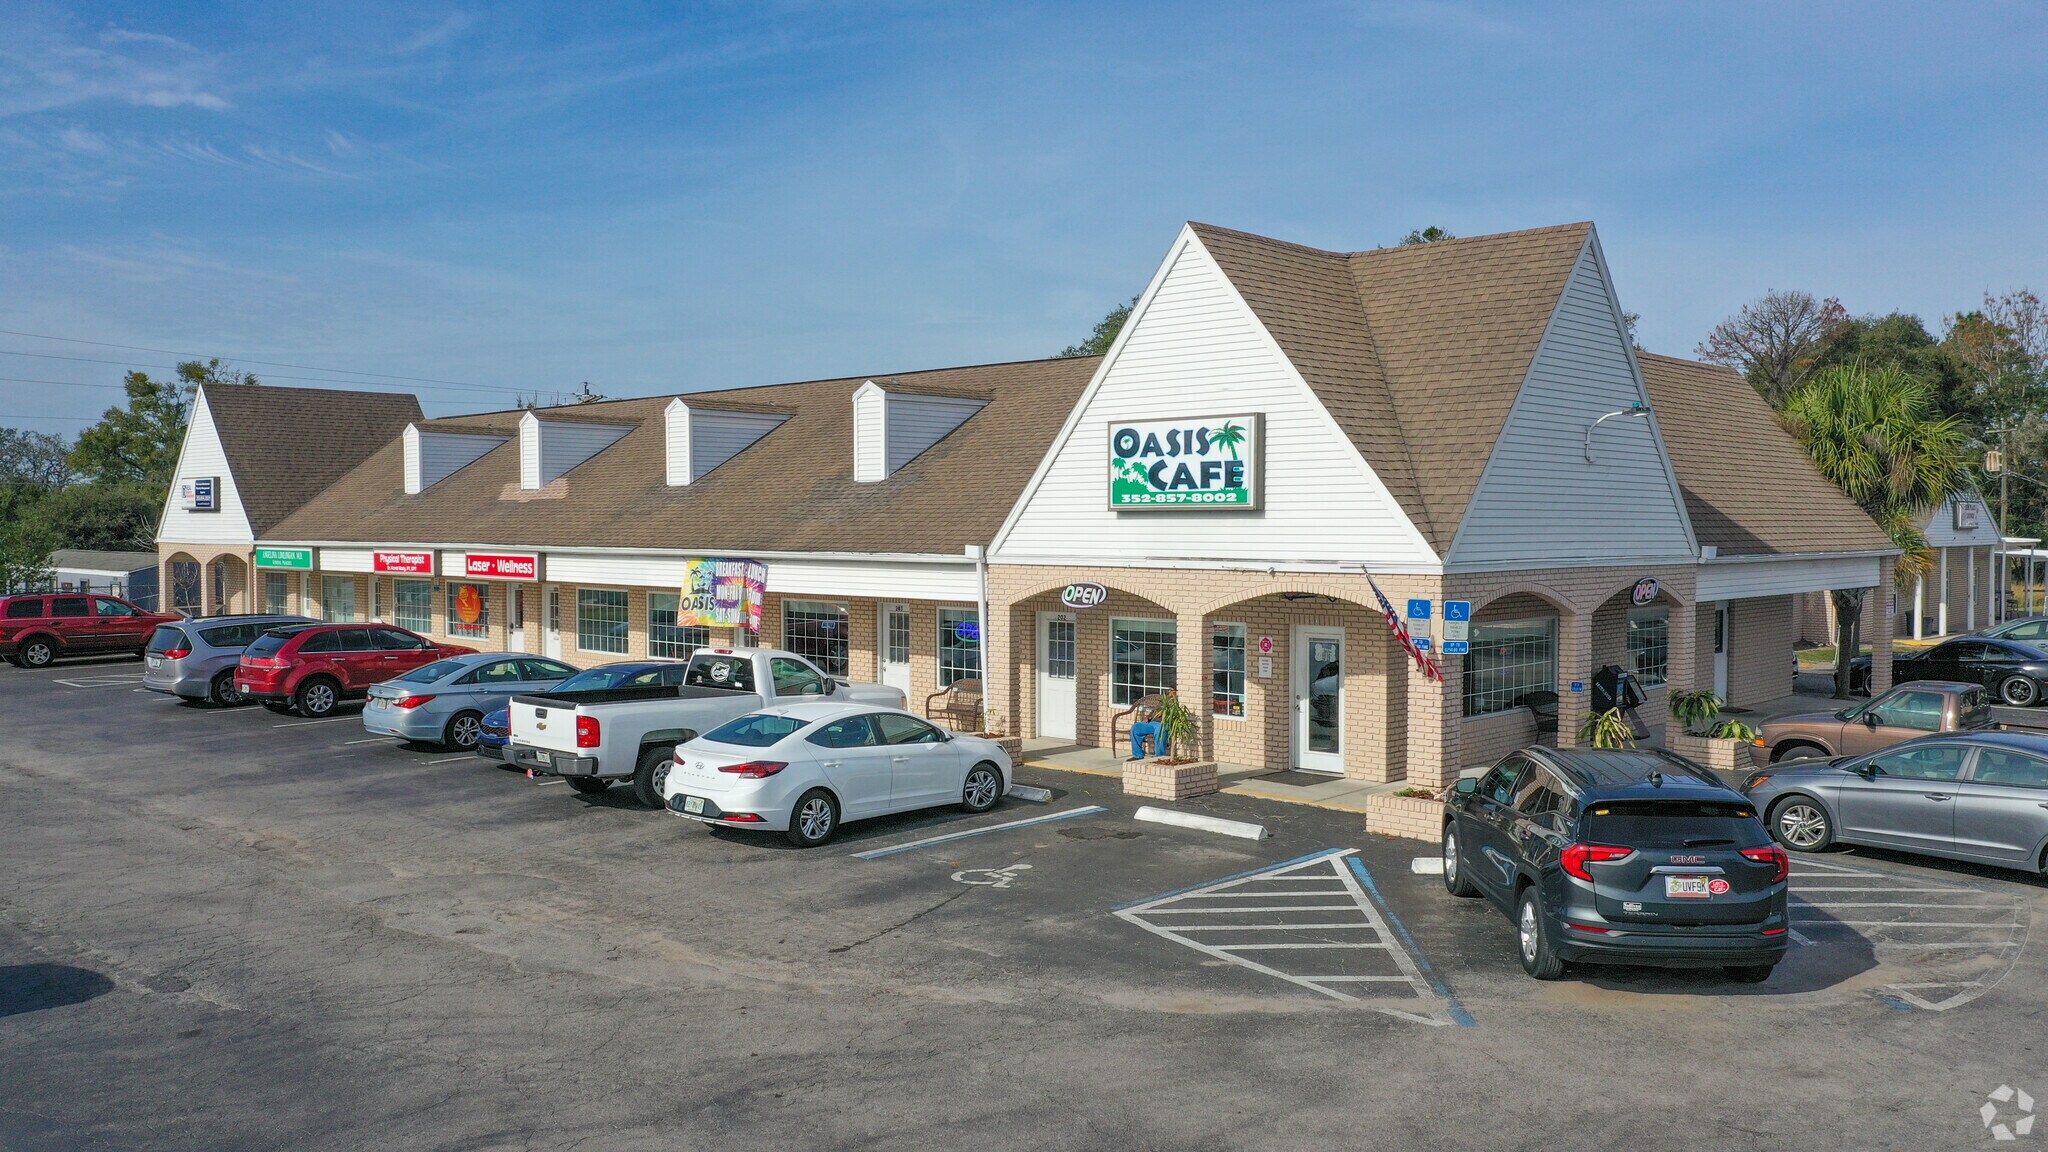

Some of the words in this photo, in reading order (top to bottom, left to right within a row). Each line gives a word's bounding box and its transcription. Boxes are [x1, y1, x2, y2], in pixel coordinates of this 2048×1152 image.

[1113, 426, 1211, 458] OASIS
[1148, 459, 1245, 491] CAFE
[1121, 492, 1237, 503] 352-857-8002
[379, 554, 400, 565] Physical
[400, 554, 425, 566] Therapist
[467, 558, 490, 572] Laser
[496, 559, 533, 574] Wellness
[715, 561, 744, 577] BREAKFAST
[1064, 585, 1101, 604] OPEN
[1635, 583, 1656, 600] OPEN
[681, 596, 715, 611] OASIS
[1670, 855, 1705, 864] GMC
[1682, 881, 1707, 892] UVF9K
